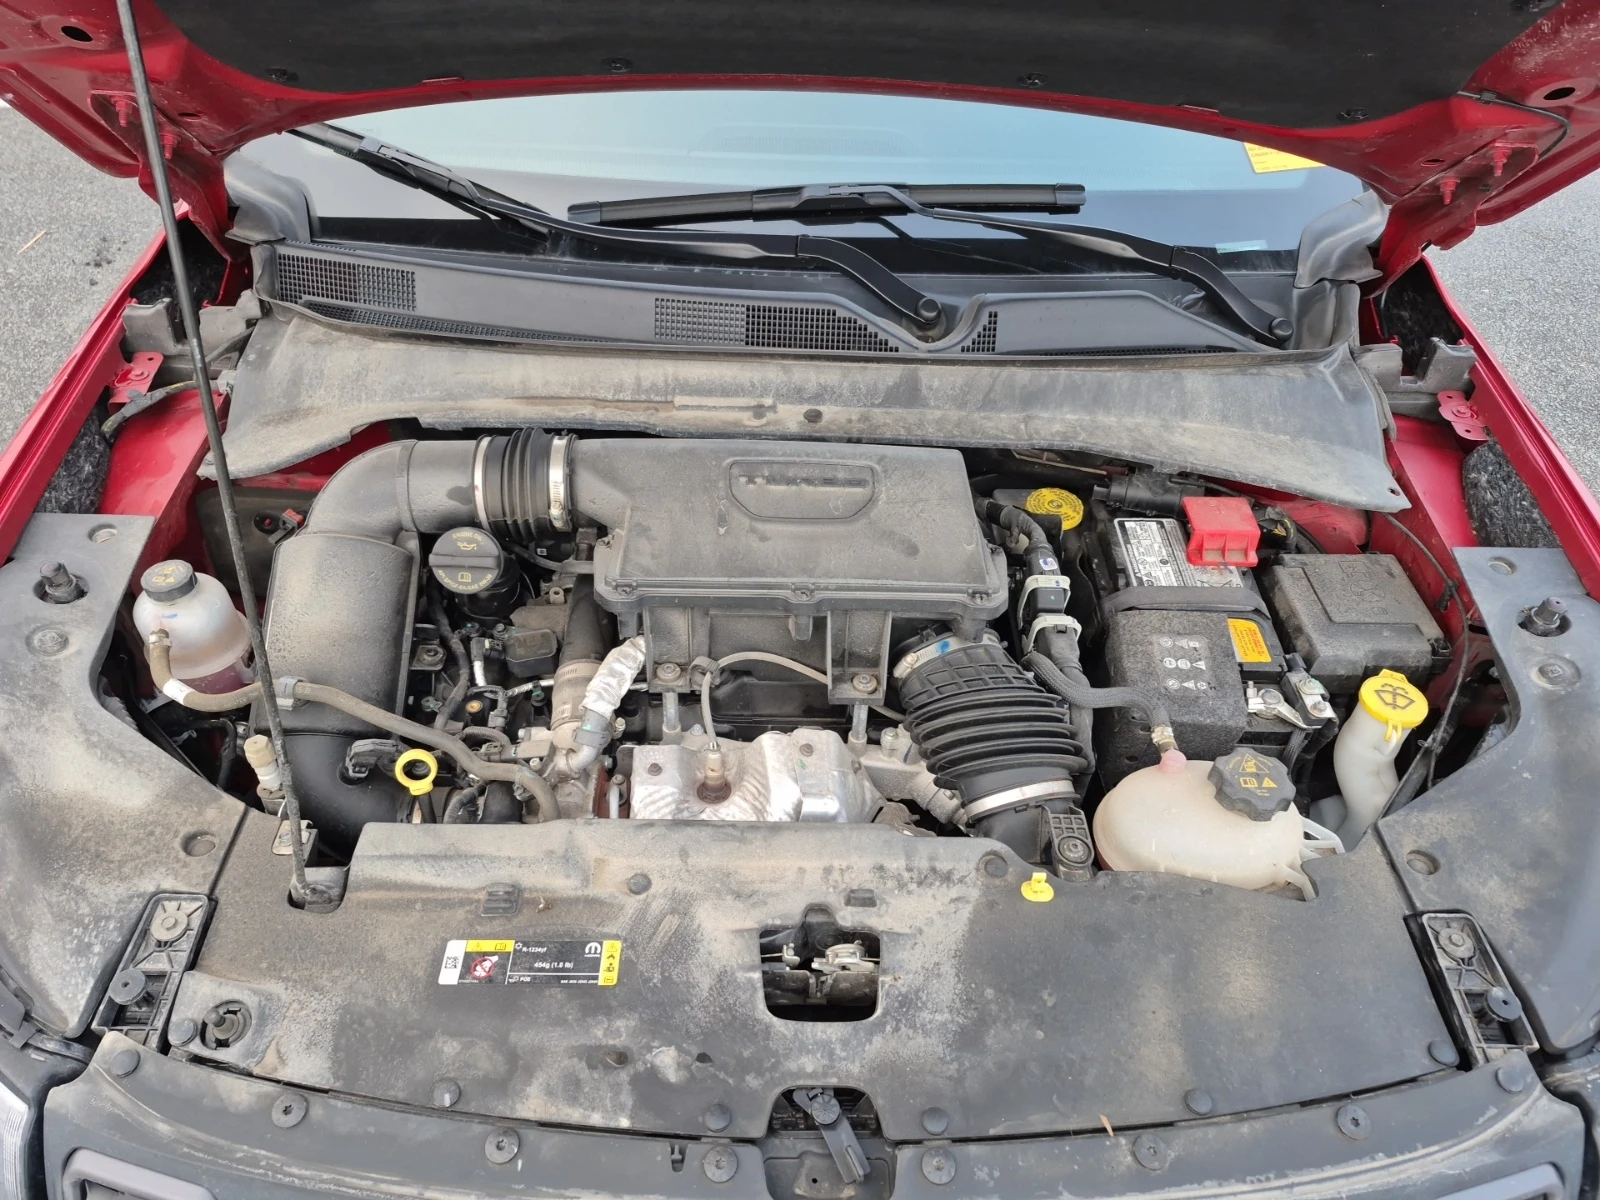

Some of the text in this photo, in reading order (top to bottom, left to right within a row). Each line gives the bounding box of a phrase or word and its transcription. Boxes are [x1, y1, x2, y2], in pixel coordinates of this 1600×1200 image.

[452, 531, 482, 541] ENGINE OIL
[522, 946, 547, 954] R-1234yf
[534, 961, 550, 969] 454g
